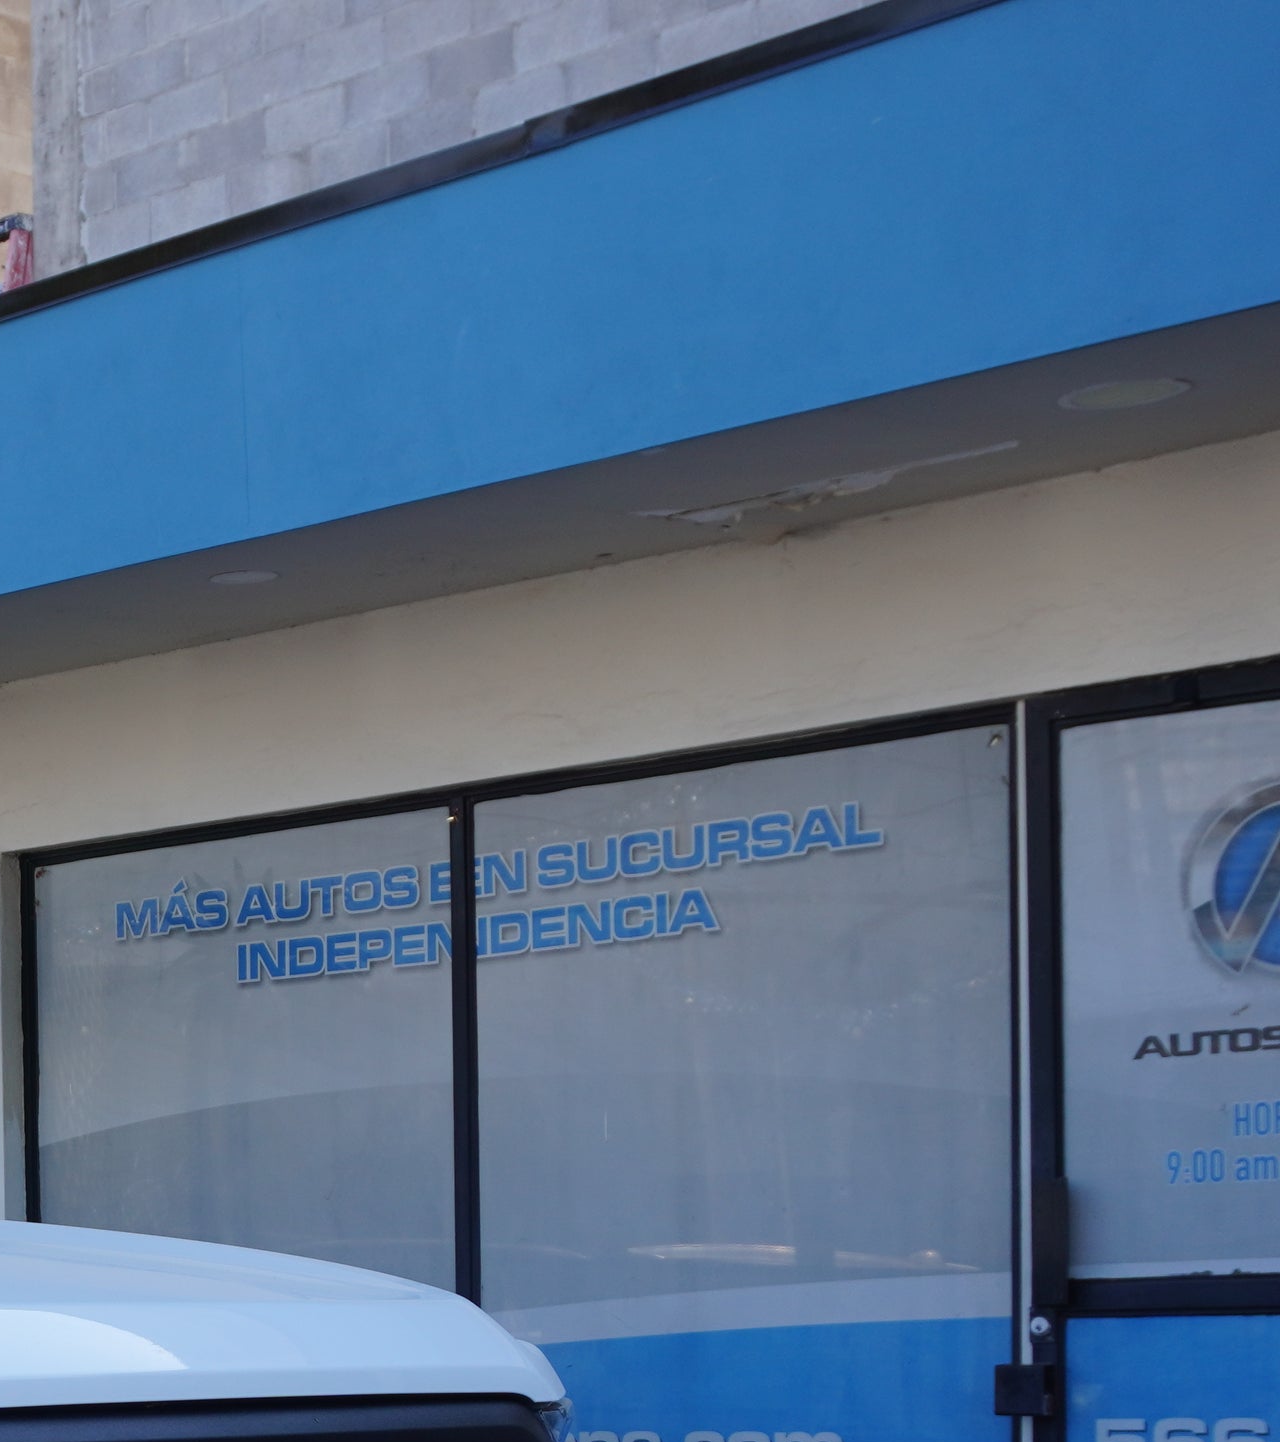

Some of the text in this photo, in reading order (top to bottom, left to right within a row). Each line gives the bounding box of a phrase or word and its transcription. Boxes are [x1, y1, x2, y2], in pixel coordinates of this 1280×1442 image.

[115, 802, 885, 941] MÁS AUTOS EN SUCURSAL
[236, 886, 722, 985] INDEPENDENCIA
[1167, 1149, 1279, 1184] 9:00 am
